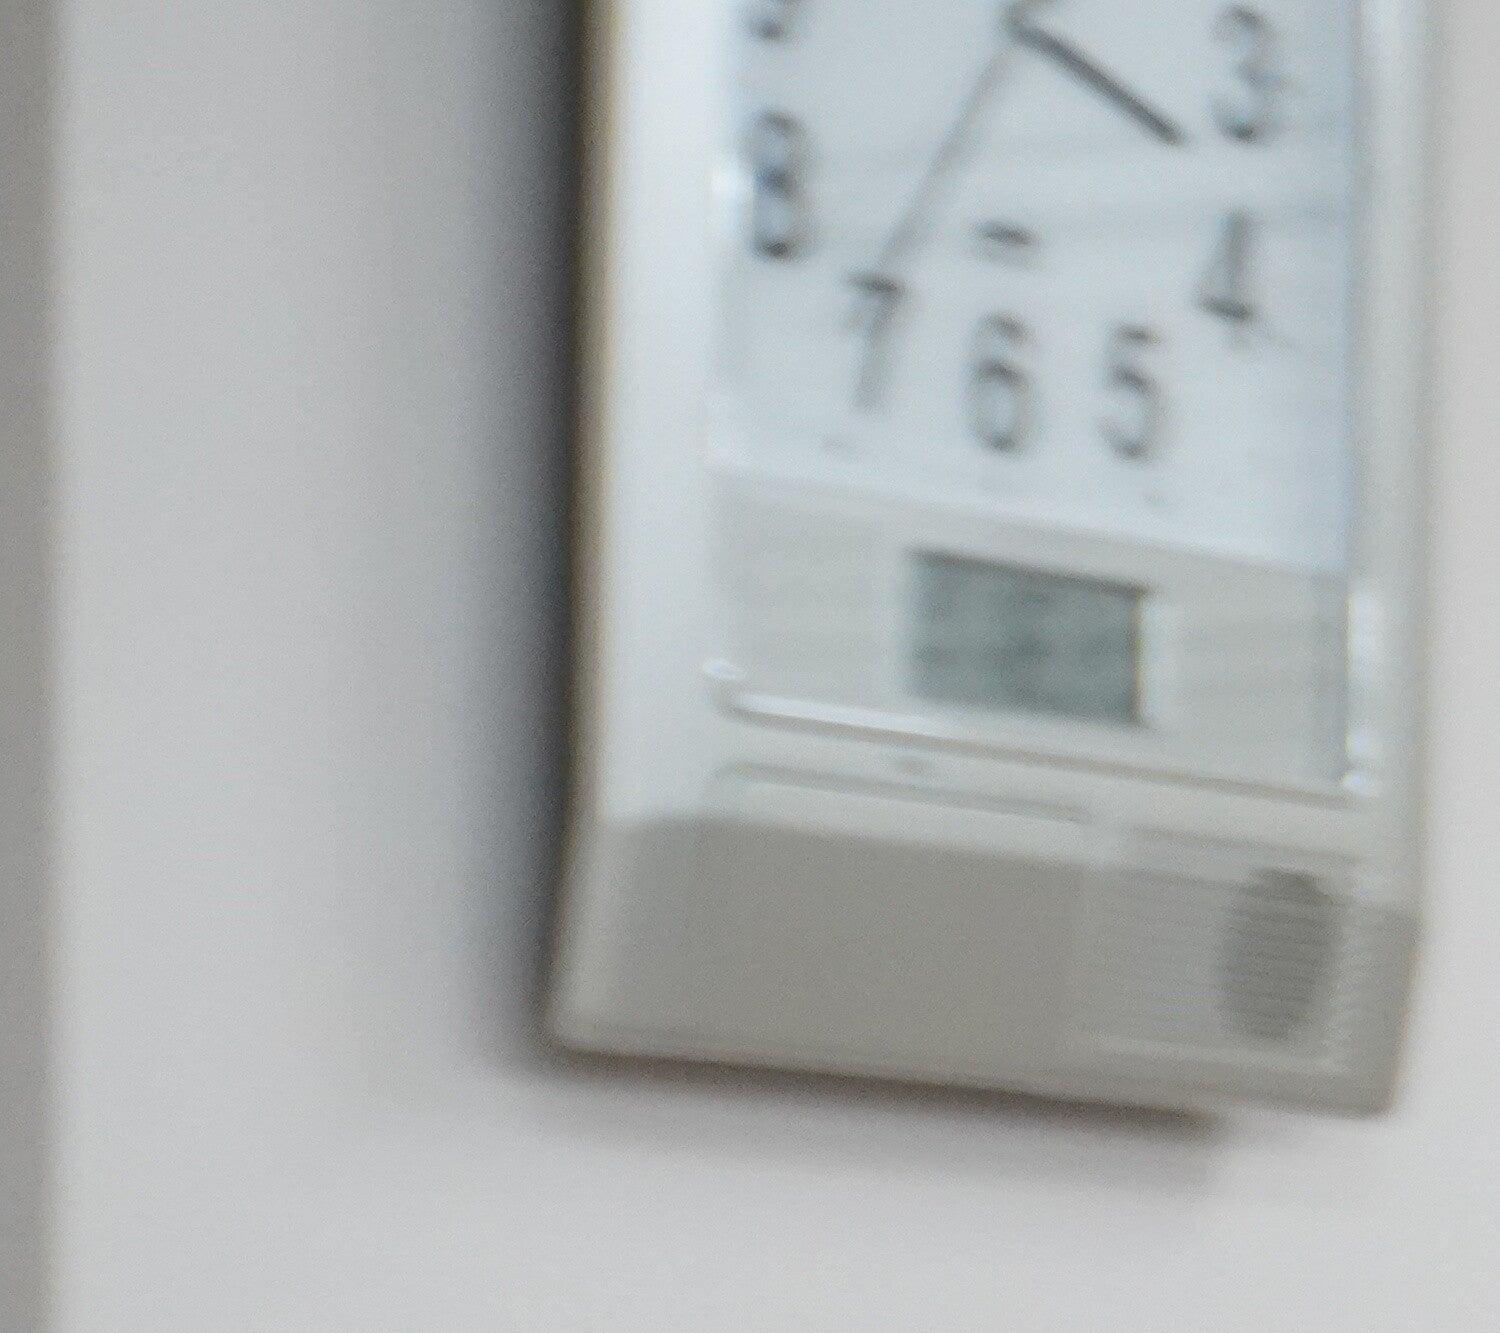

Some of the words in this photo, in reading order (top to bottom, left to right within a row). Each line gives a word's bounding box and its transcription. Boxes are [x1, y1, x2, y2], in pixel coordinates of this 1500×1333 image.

[1209, 3, 1276, 143] 3
[745, 108, 811, 262] 8
[842, 270, 908, 411] 7
[1194, 208, 1260, 350] 4
[967, 312, 1037, 456] 6
[1099, 322, 1165, 463] 5
